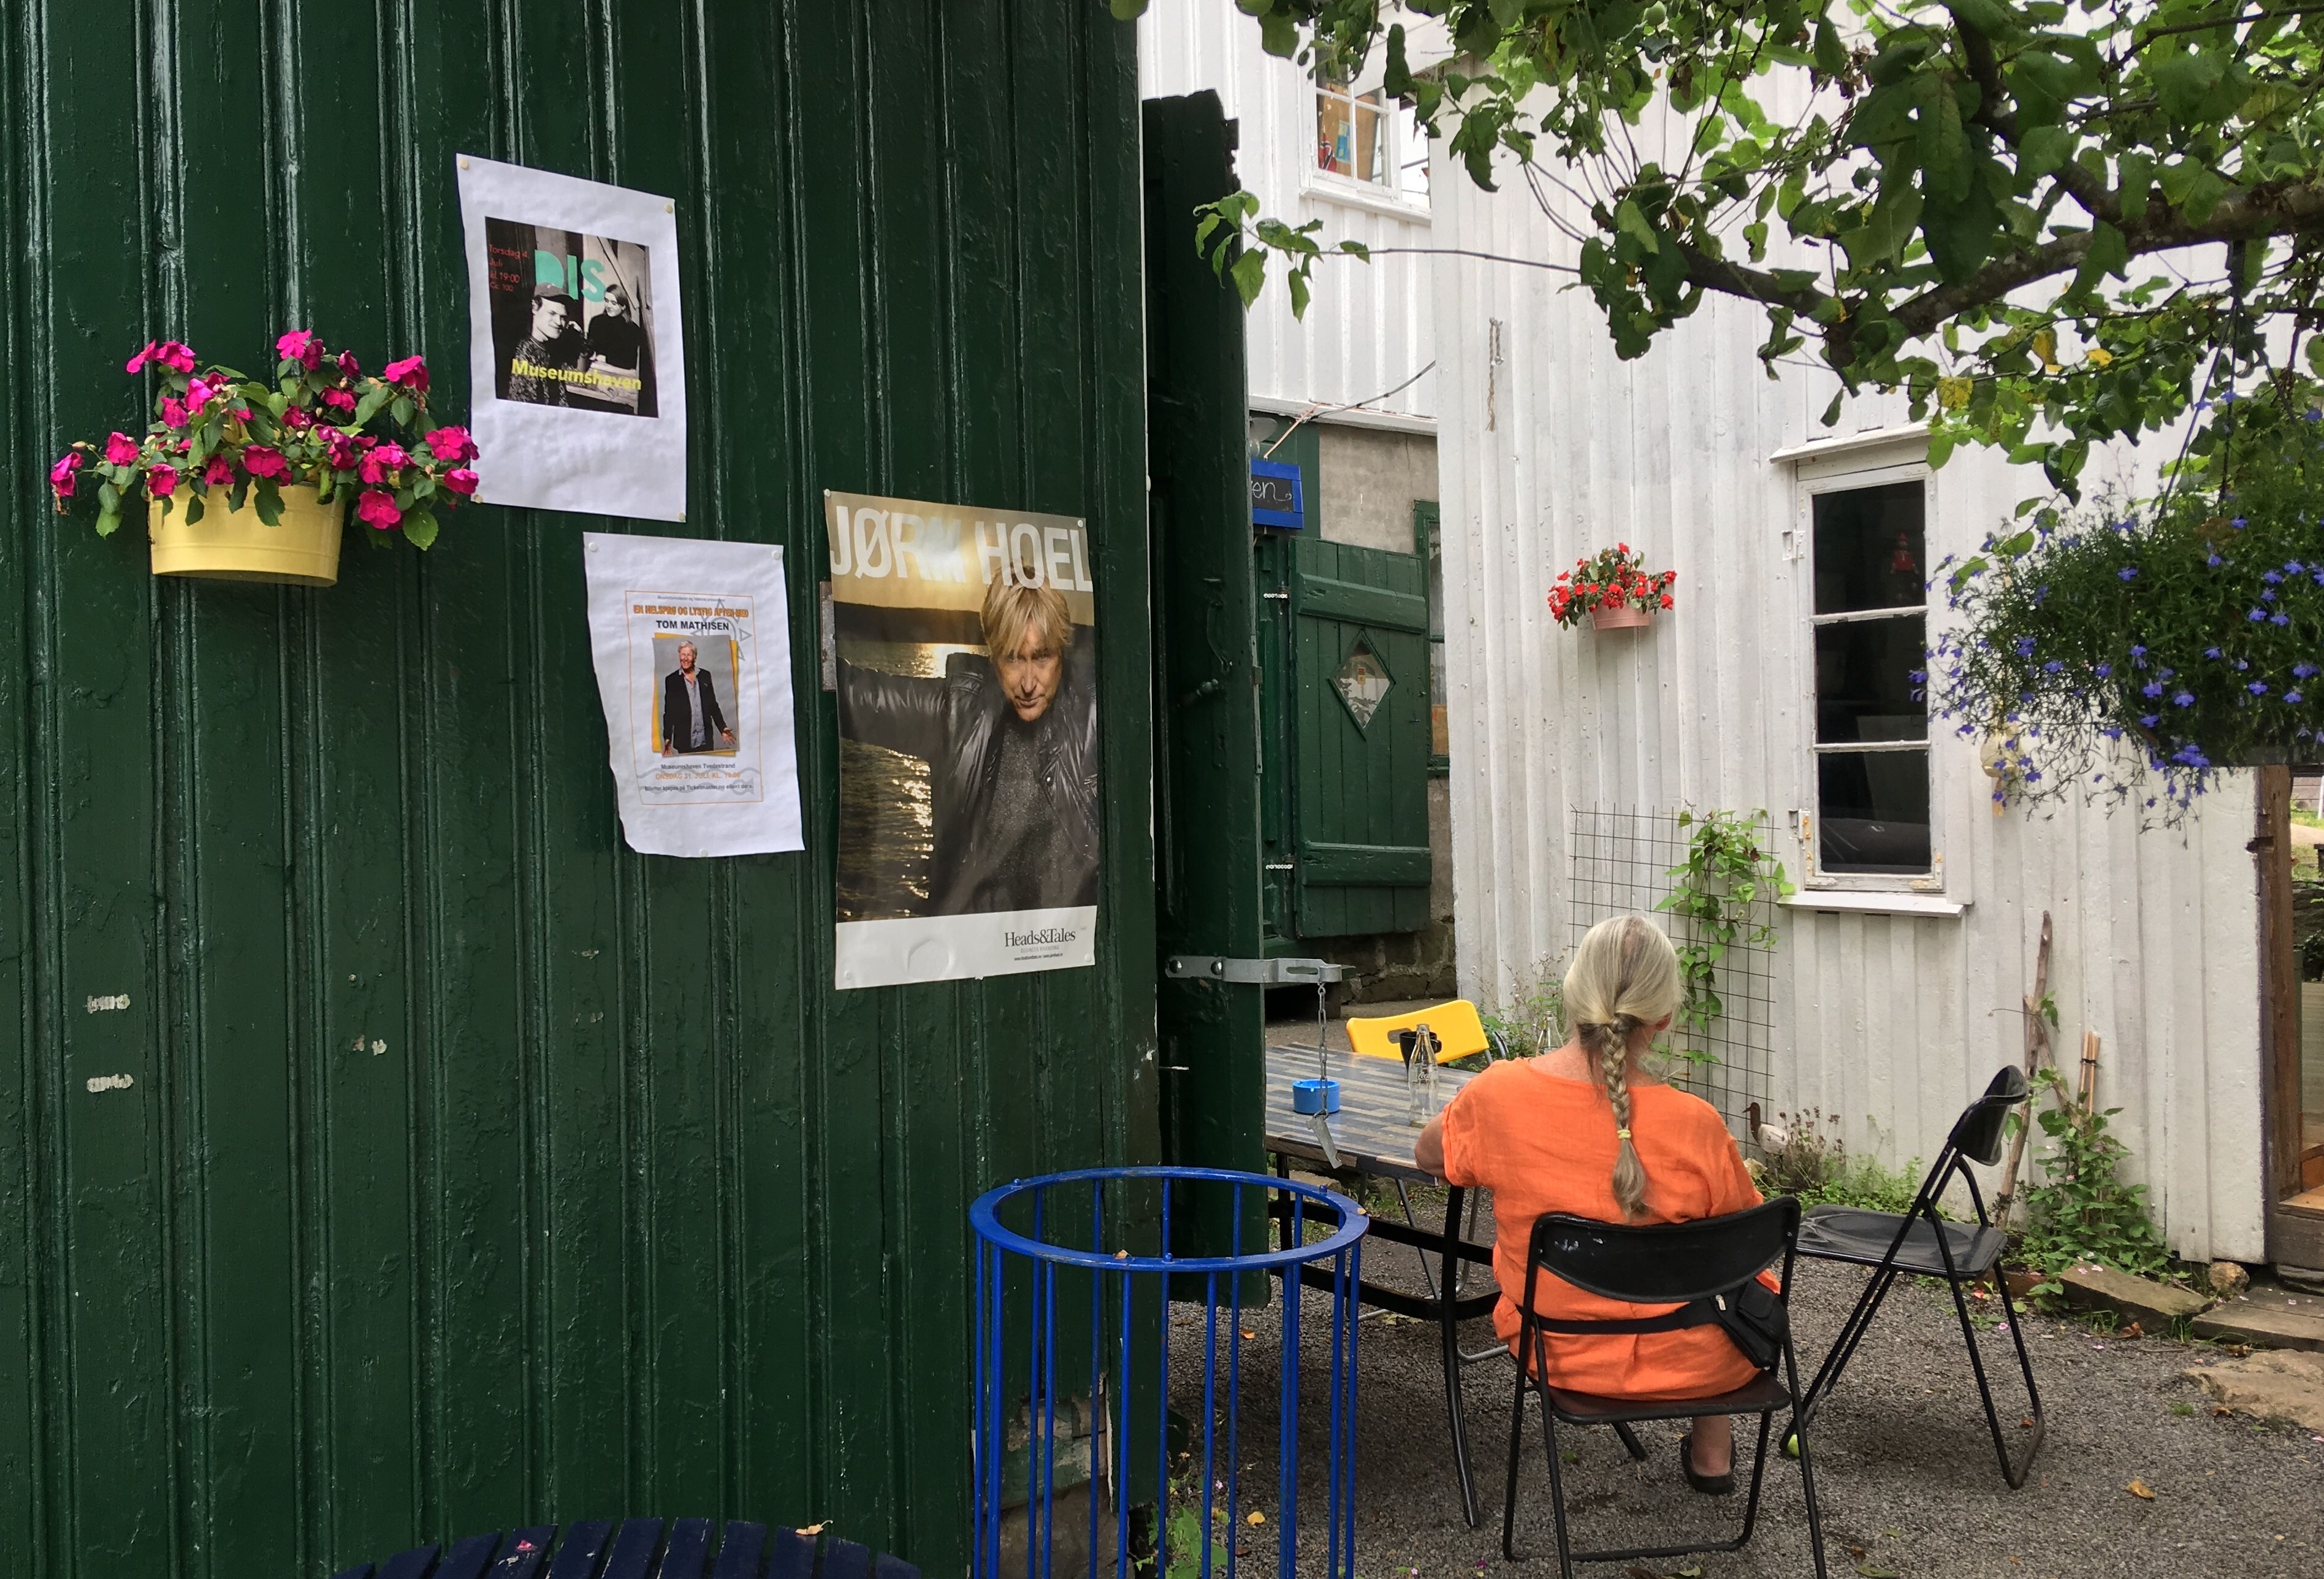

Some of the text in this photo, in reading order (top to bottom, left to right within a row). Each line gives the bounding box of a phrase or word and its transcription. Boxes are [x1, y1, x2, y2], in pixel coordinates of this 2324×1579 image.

[489, 244, 520, 260] Torsdag
[535, 250, 606, 302] DIS
[511, 359, 642, 390] Museumshaven
[1251, 480, 1292, 502] en
[830, 506, 1094, 592] JØRN HOEL
[633, 605, 644, 614] EN
[677, 607, 687, 616] OG
[689, 607, 712, 616] LYSTIG
[656, 620, 730, 630] TOM MATHISEN
[1005, 928, 1076, 947] Heads&Tales
